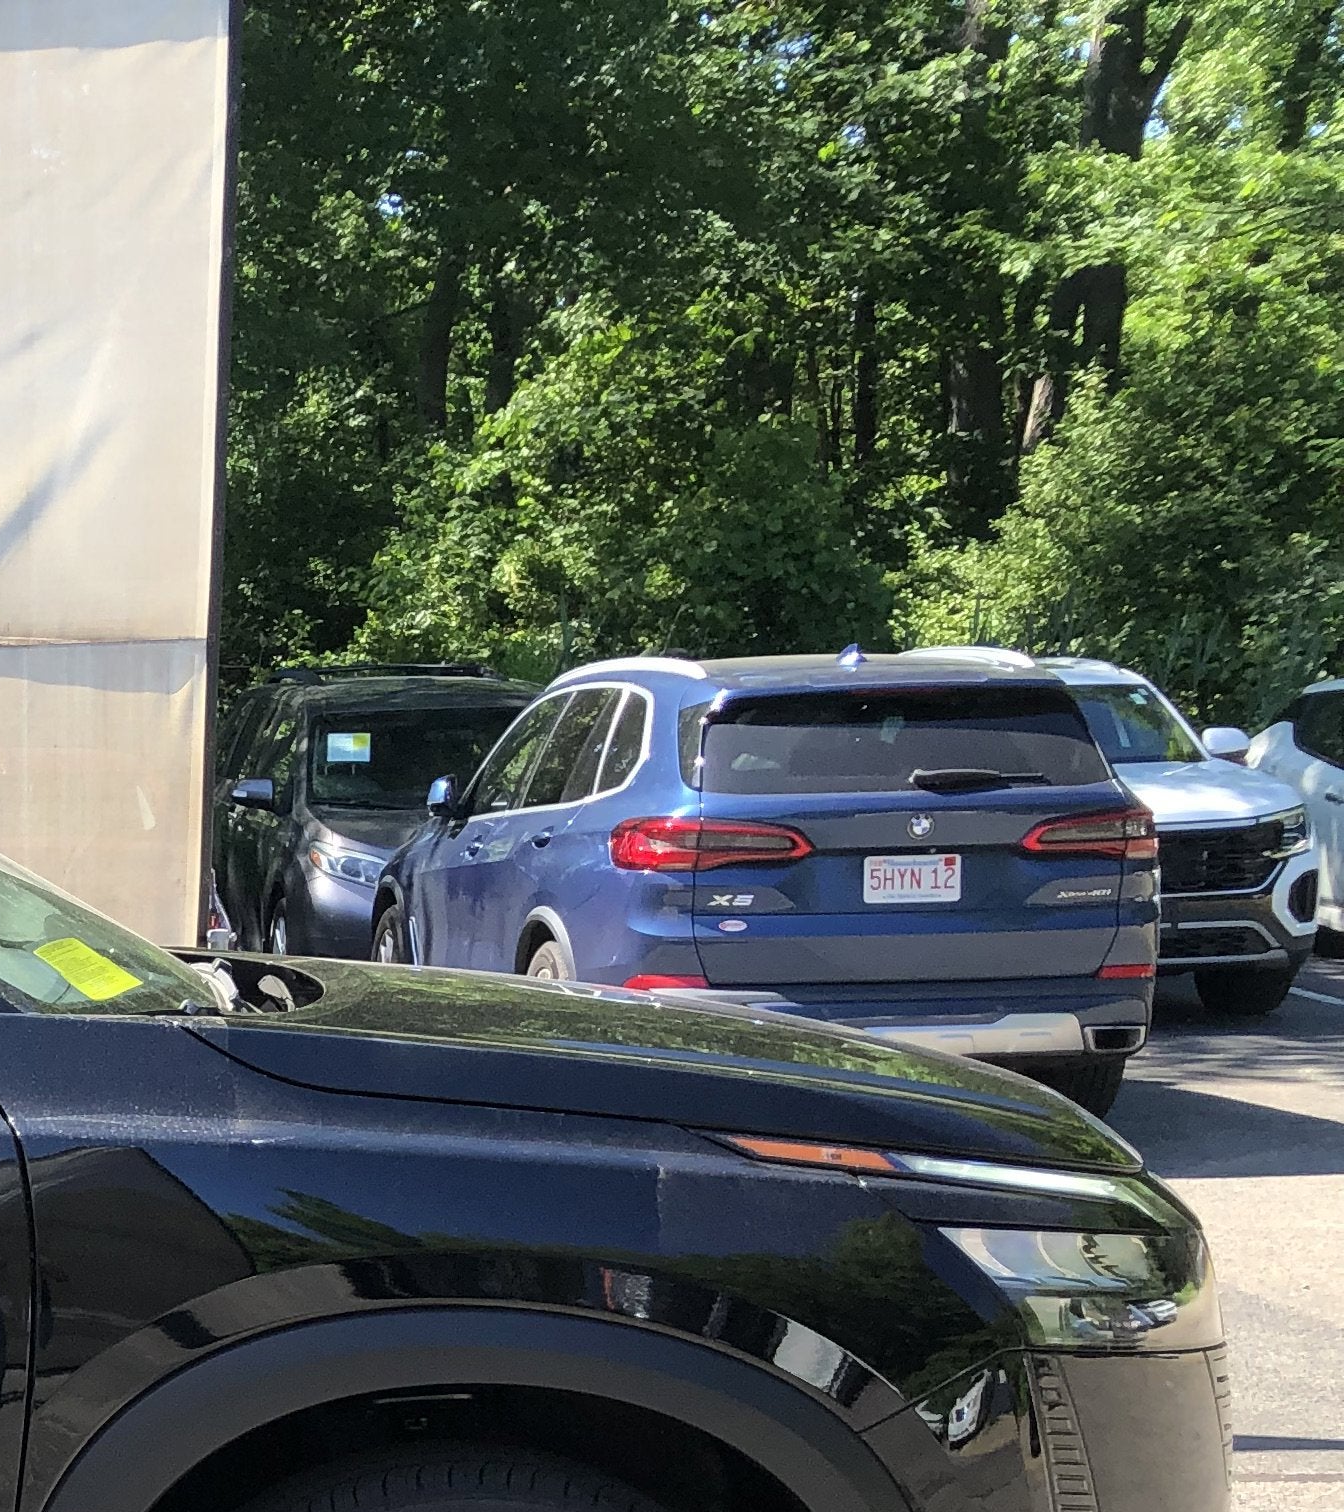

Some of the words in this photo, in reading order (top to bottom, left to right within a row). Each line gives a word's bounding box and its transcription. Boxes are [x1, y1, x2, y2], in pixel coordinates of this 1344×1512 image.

[869, 867, 922, 891] 5HYN
[930, 866, 956, 890] 12
[707, 894, 754, 906] X5
